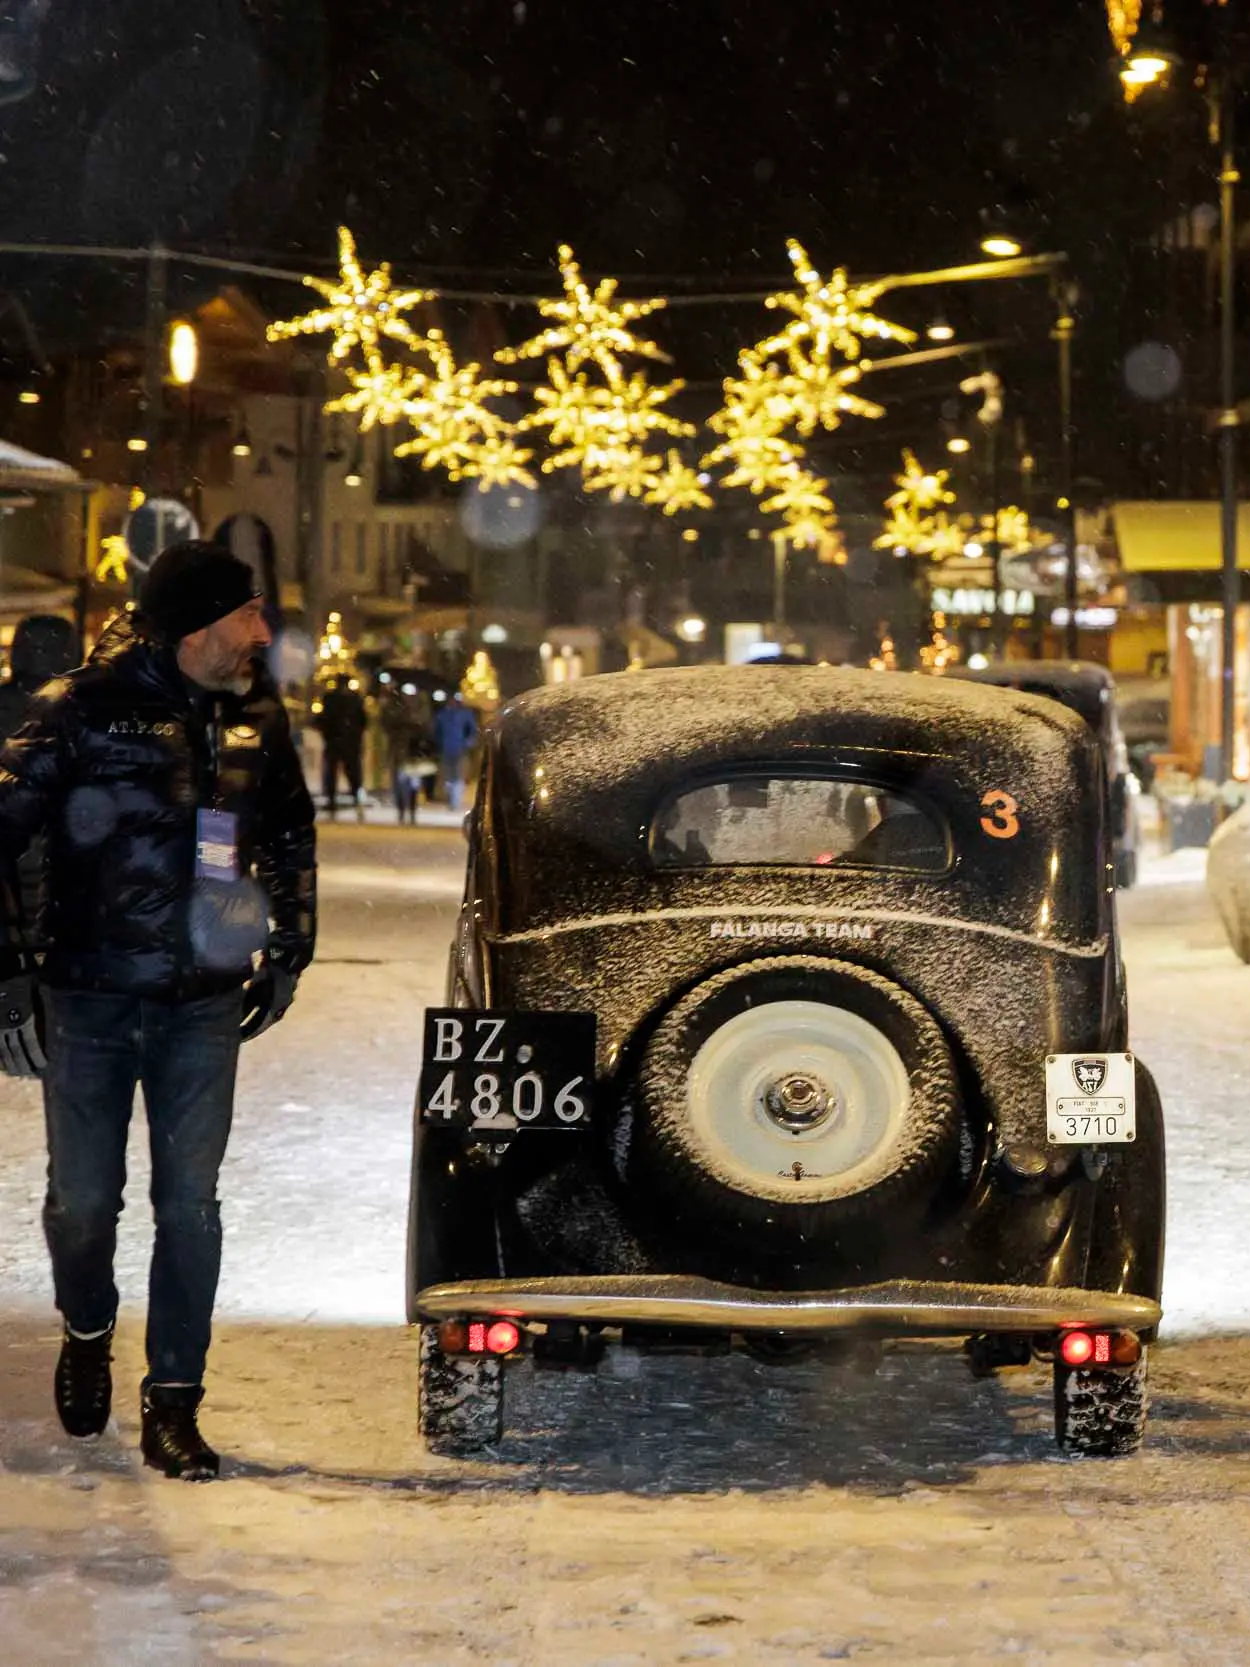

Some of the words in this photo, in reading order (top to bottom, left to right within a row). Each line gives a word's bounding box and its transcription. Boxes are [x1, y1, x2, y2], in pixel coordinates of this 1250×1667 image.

[979, 789, 1020, 839] 3
[710, 922, 806, 938] FALANGA
[814, 923, 872, 940] TEAM
[428, 1070, 584, 1122] 4806
[1066, 1116, 1117, 1137] 3710
